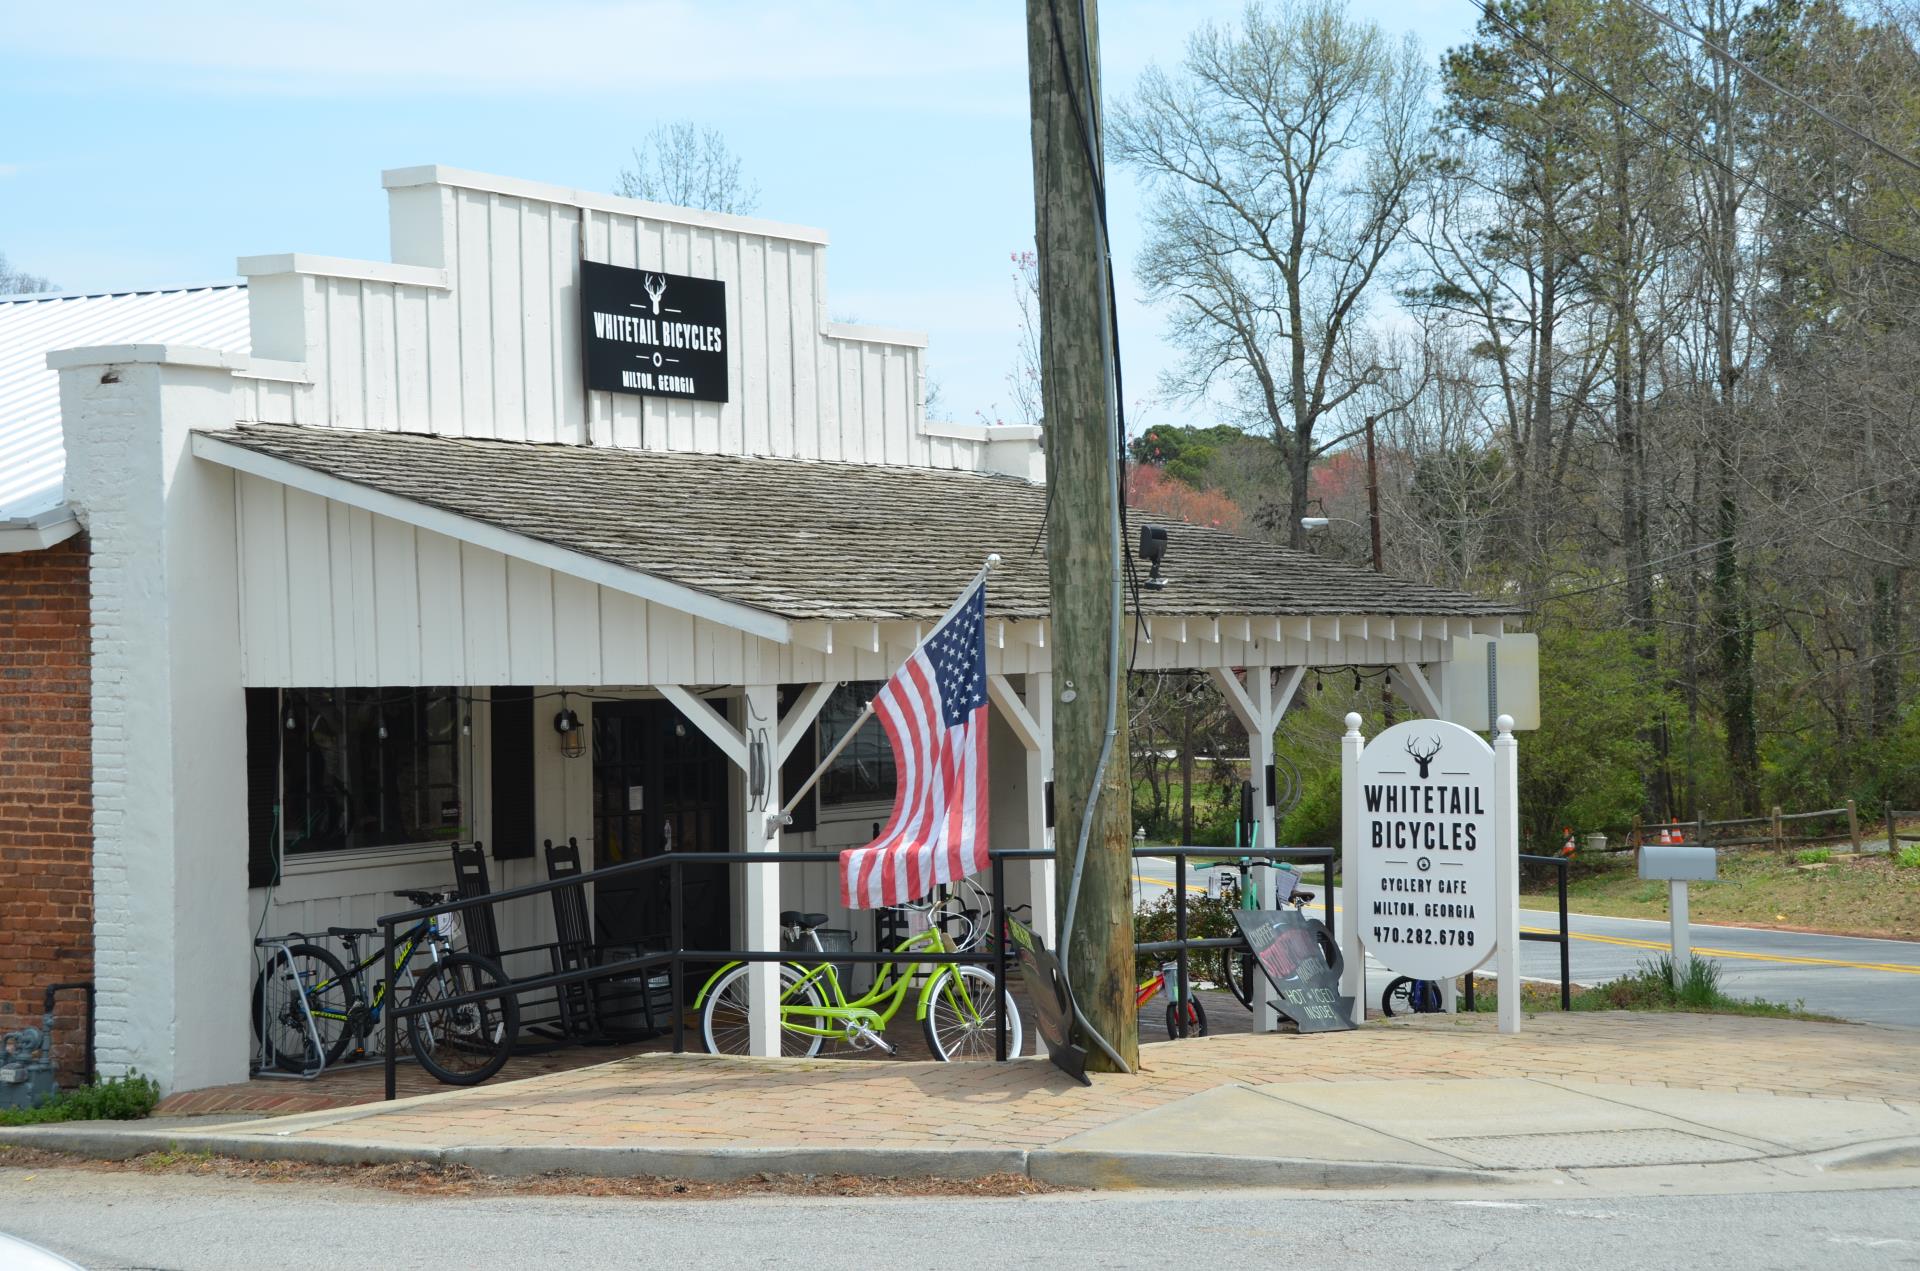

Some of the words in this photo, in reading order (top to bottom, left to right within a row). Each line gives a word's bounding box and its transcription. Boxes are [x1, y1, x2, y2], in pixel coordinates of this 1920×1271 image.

[593, 311, 659, 345] WHITETAIL
[662, 321, 722, 352] BICYCLES
[622, 370, 656, 391] MILTON,
[658, 374, 695, 394] GEORGIA
[1364, 784, 1485, 815] WHITETAIL
[1372, 820, 1477, 851] BICYCLES
[1381, 877, 1432, 893] CYCLERY
[1438, 879, 1467, 894] CAFE
[1373, 901, 1419, 917] MILTON,
[1424, 903, 1475, 919] GEORGIA
[1373, 926, 1475, 947] 470.282.6789
[1285, 988, 1307, 1005] HOT
[1311, 988, 1336, 1003] ICED
